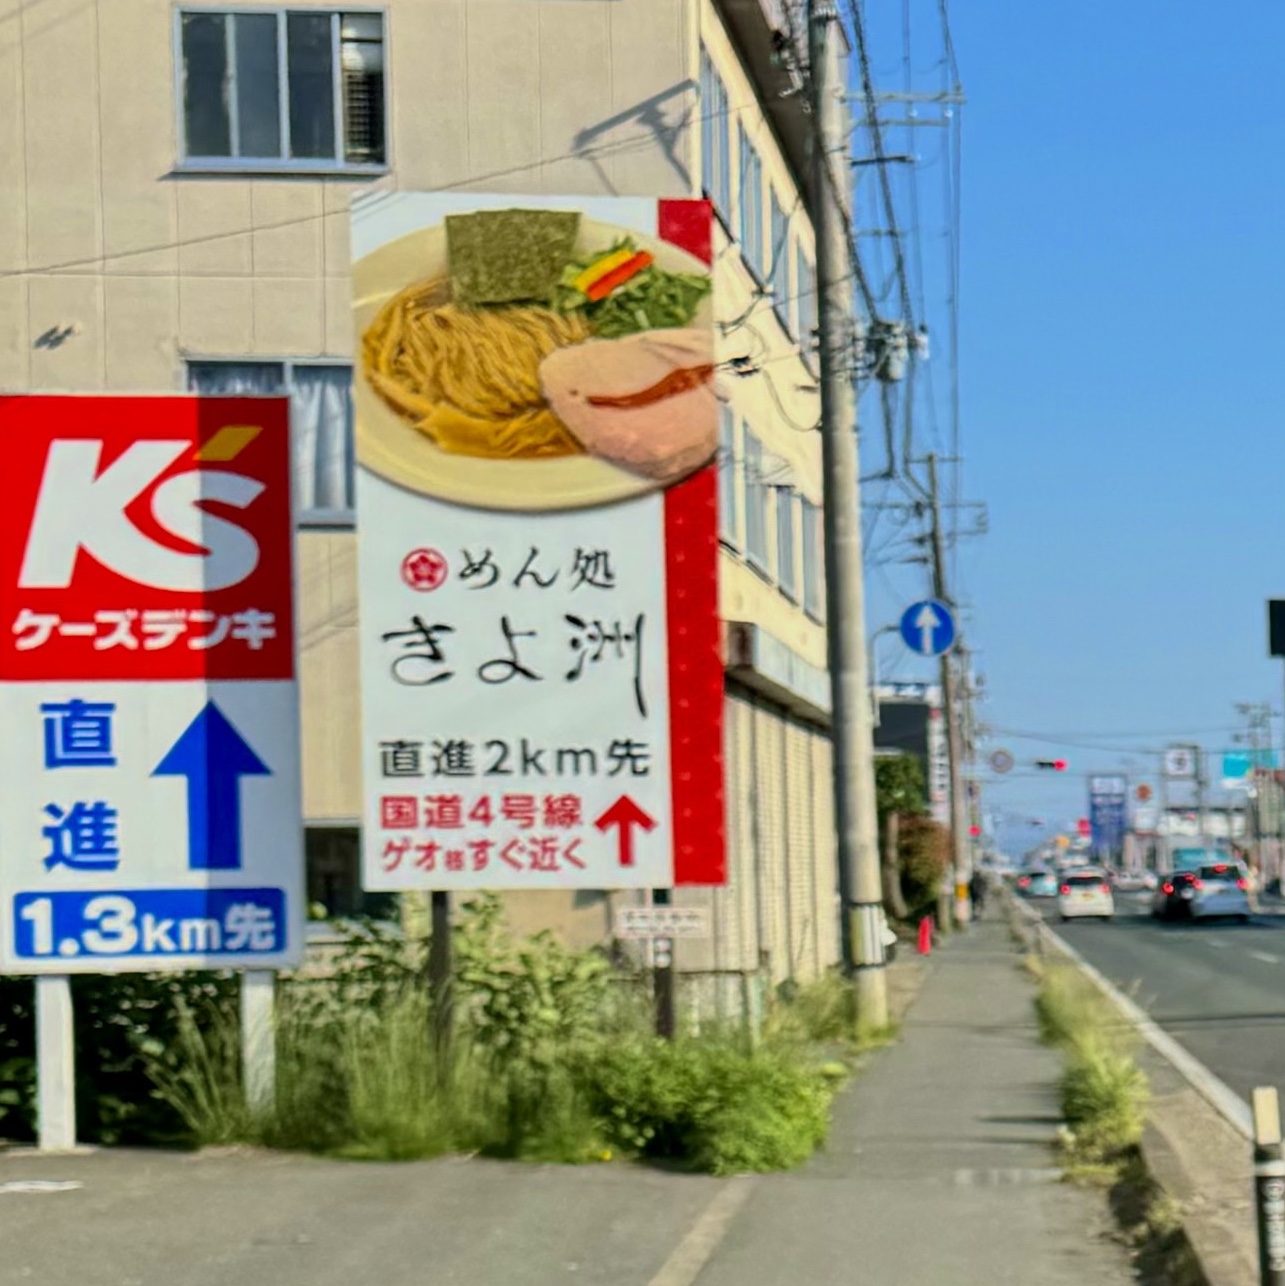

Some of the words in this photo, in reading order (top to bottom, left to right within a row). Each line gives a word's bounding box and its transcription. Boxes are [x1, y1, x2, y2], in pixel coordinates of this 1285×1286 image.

[457, 546, 617, 592] めん処
[11, 608, 277, 651] ケーズデンキ
[379, 611, 648, 719] きよ洲
[377, 738, 652, 778] 直進2km先
[39, 698, 120, 873] 直進
[380, 793, 584, 830] 国道4号線
[20, 895, 277, 958] 1.3km先
